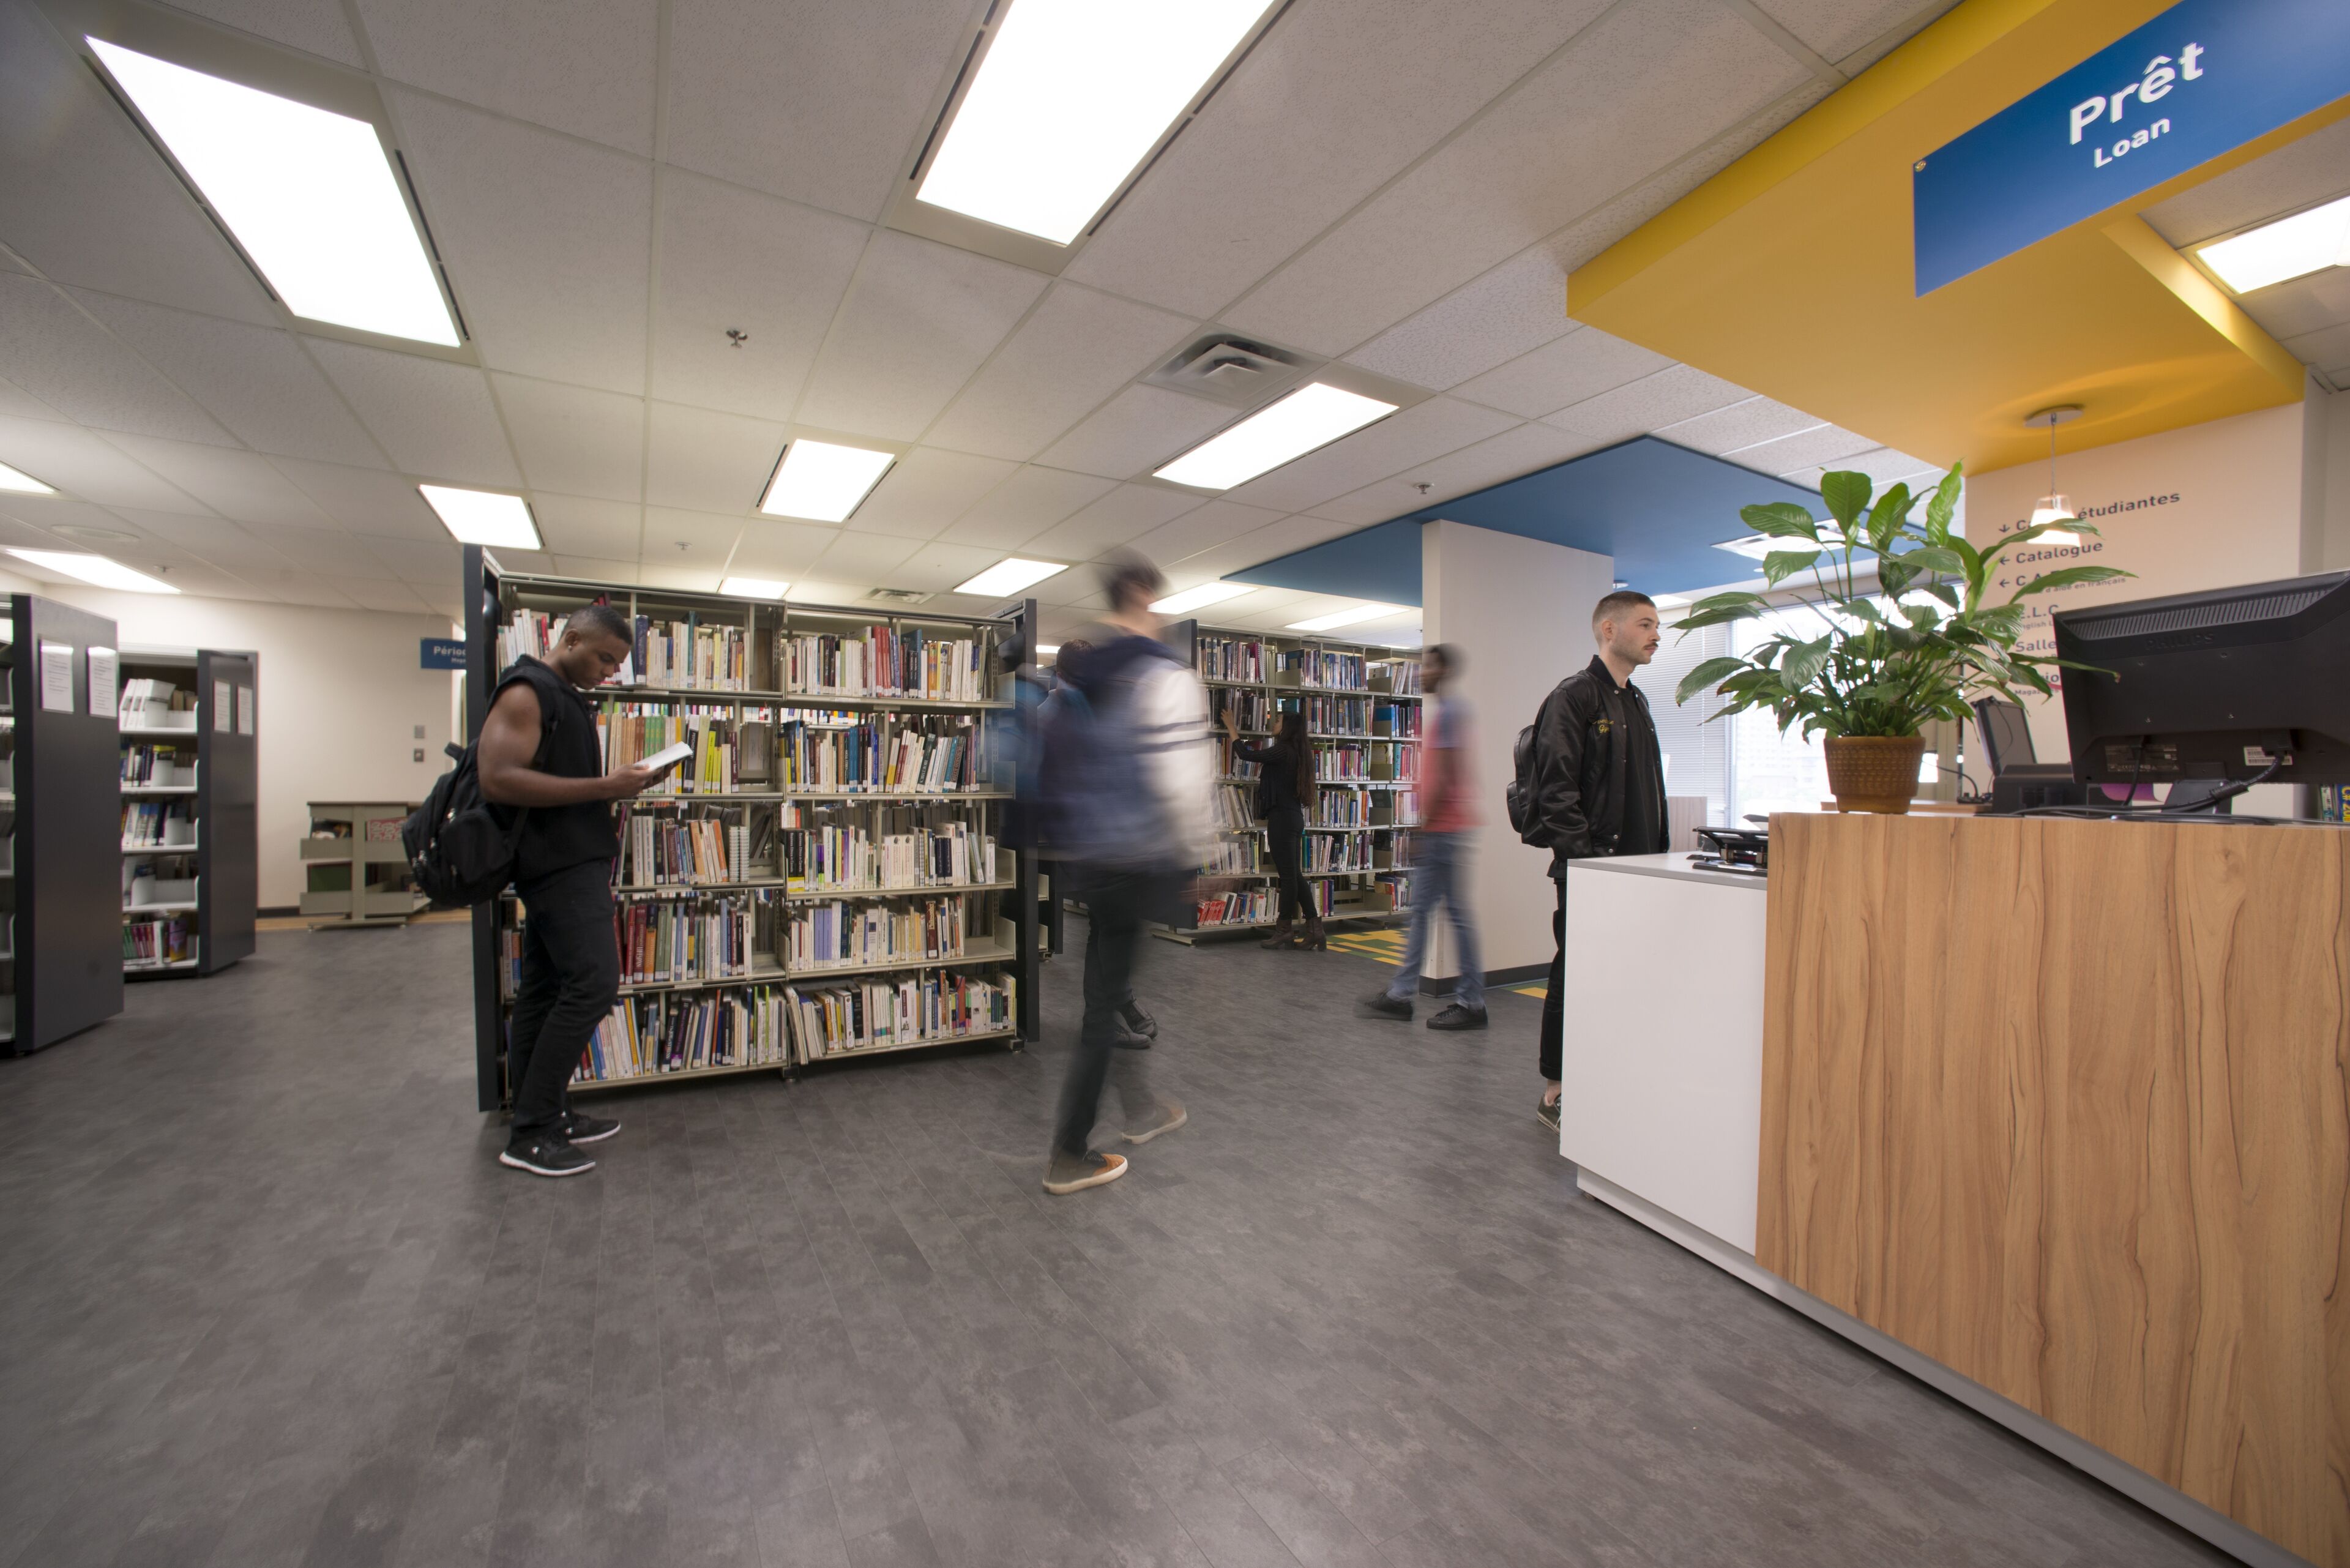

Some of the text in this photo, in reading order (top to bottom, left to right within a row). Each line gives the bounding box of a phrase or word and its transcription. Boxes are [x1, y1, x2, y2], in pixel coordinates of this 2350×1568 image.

[2070, 42, 2204, 145] Prêt
[2094, 118, 2170, 168] Loan
[2078, 492, 2180, 520] étudiantes
[2016, 542, 2103, 564] Catalogue
[2015, 640, 2057, 652] Salle
